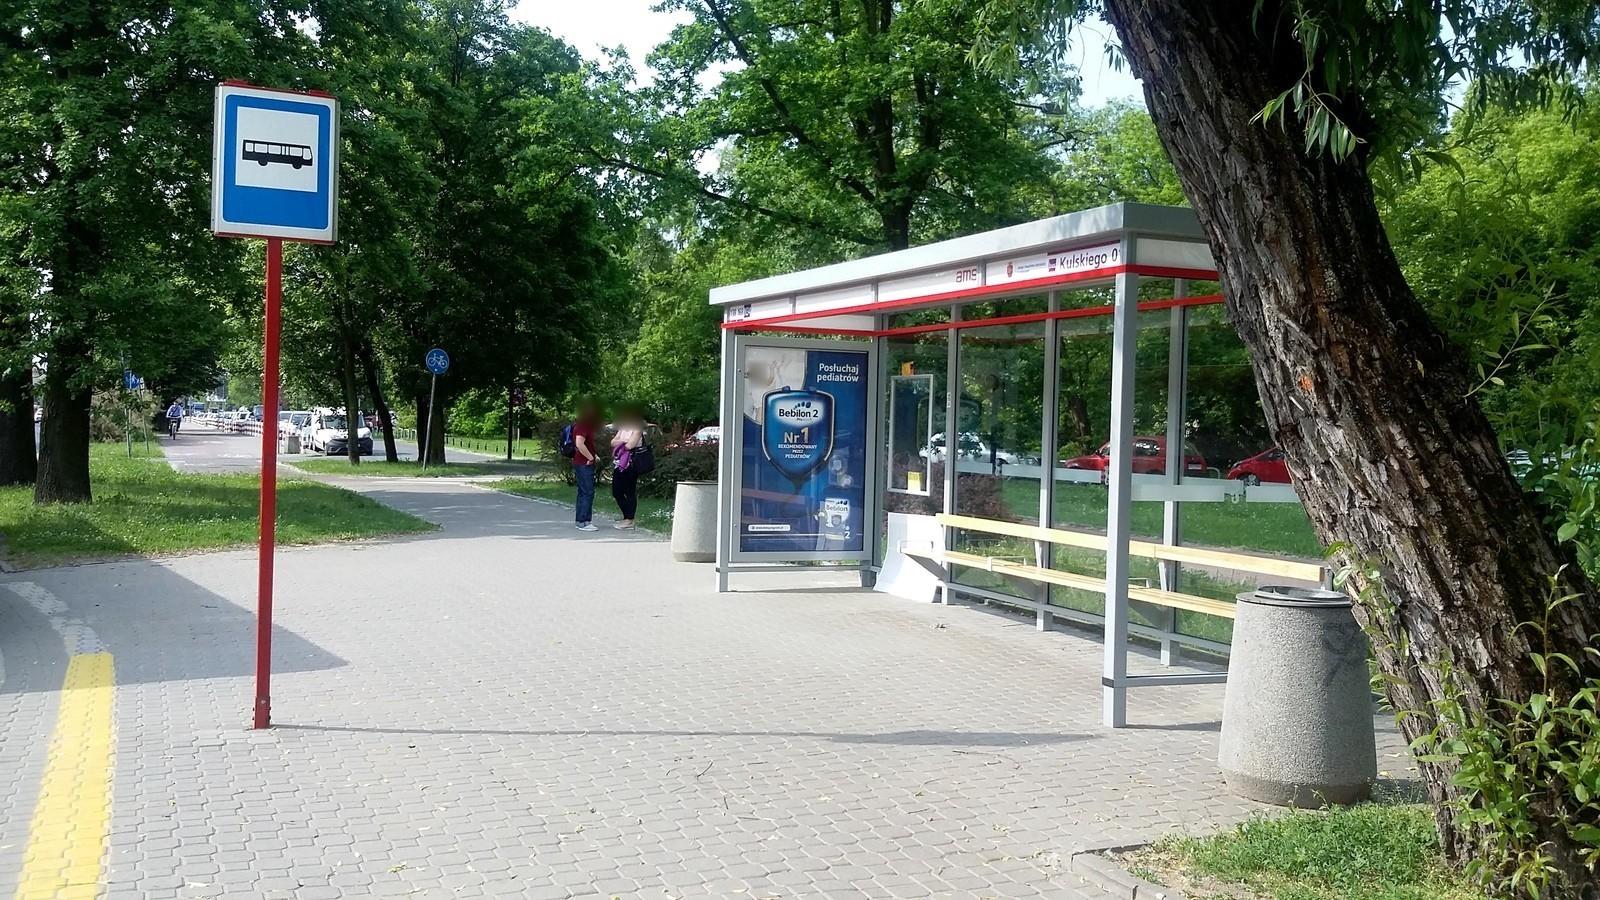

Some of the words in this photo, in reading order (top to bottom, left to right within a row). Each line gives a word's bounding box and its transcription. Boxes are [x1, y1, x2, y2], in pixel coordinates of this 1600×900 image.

[1060, 252, 1107, 269] Kulskiego
[956, 269, 977, 283] ams
[819, 363, 859, 375] Posłuchaj
[817, 373, 859, 383] pediatrów
[779, 409, 811, 418] Bebilon
[812, 409, 819, 418] 2
[784, 431, 800, 444] Nr
[800, 426, 809, 444] 1
[844, 531, 851, 539] 2
